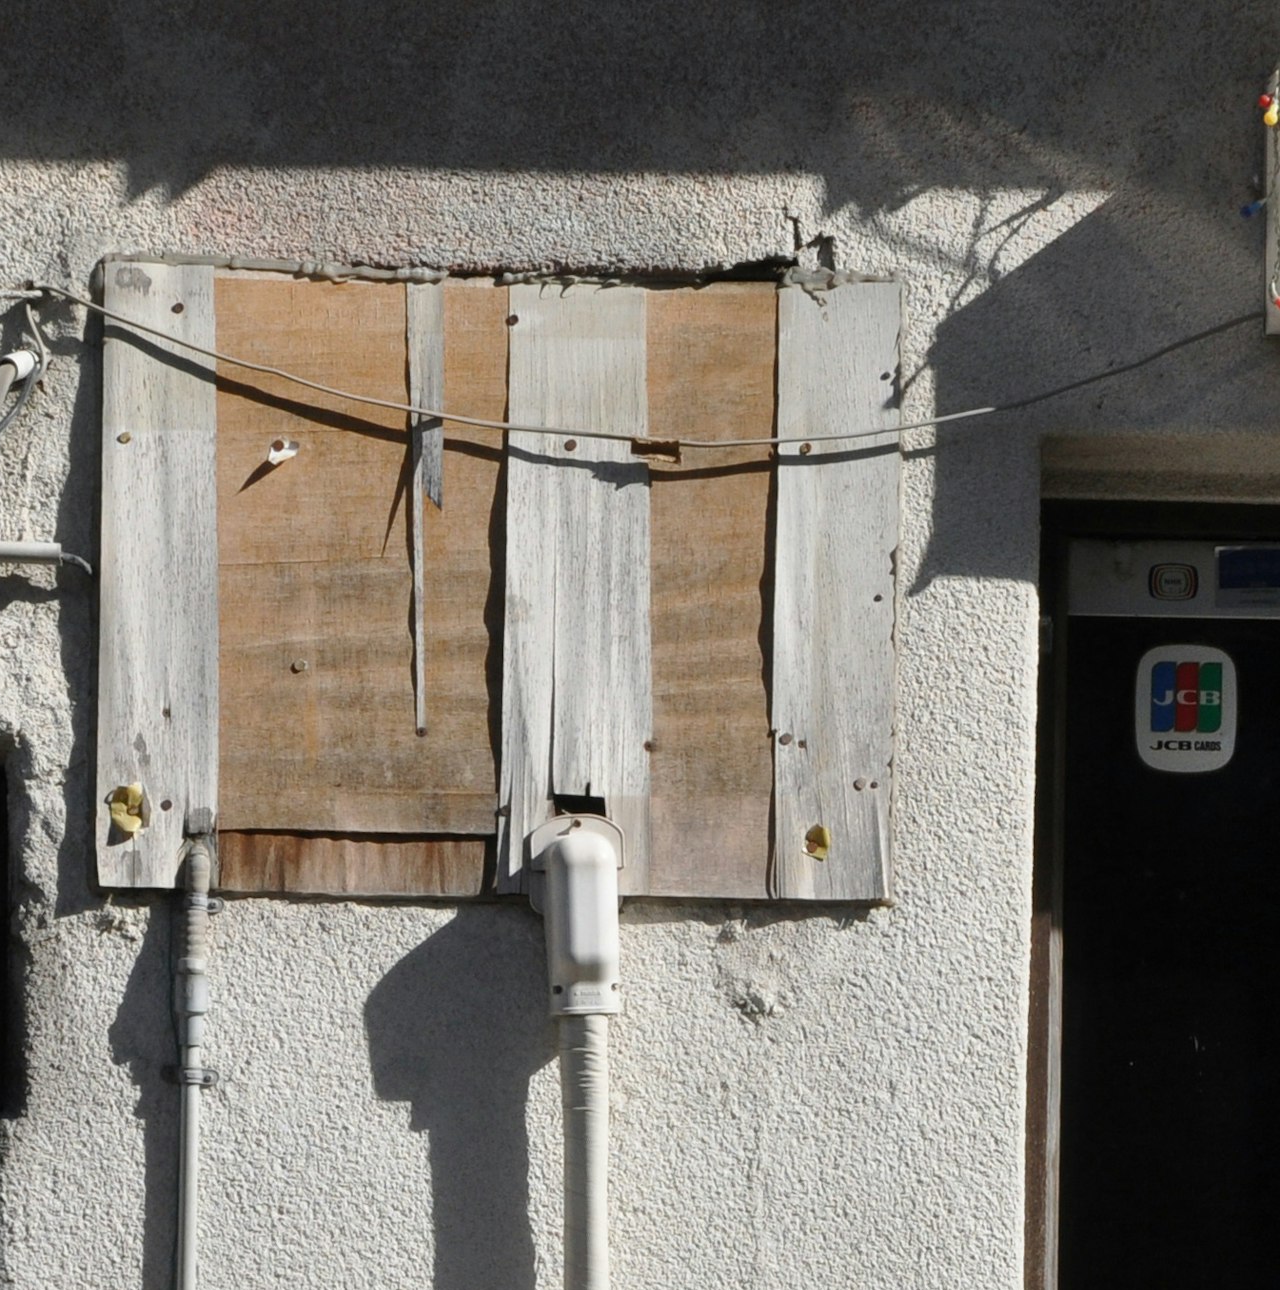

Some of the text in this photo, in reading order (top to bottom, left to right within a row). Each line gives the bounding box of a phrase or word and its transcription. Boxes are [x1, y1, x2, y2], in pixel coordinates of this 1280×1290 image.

[1163, 577, 1183, 586] NHK
[1153, 689, 1221, 706] JCB
[1149, 740, 1222, 752] JCB CARDS
